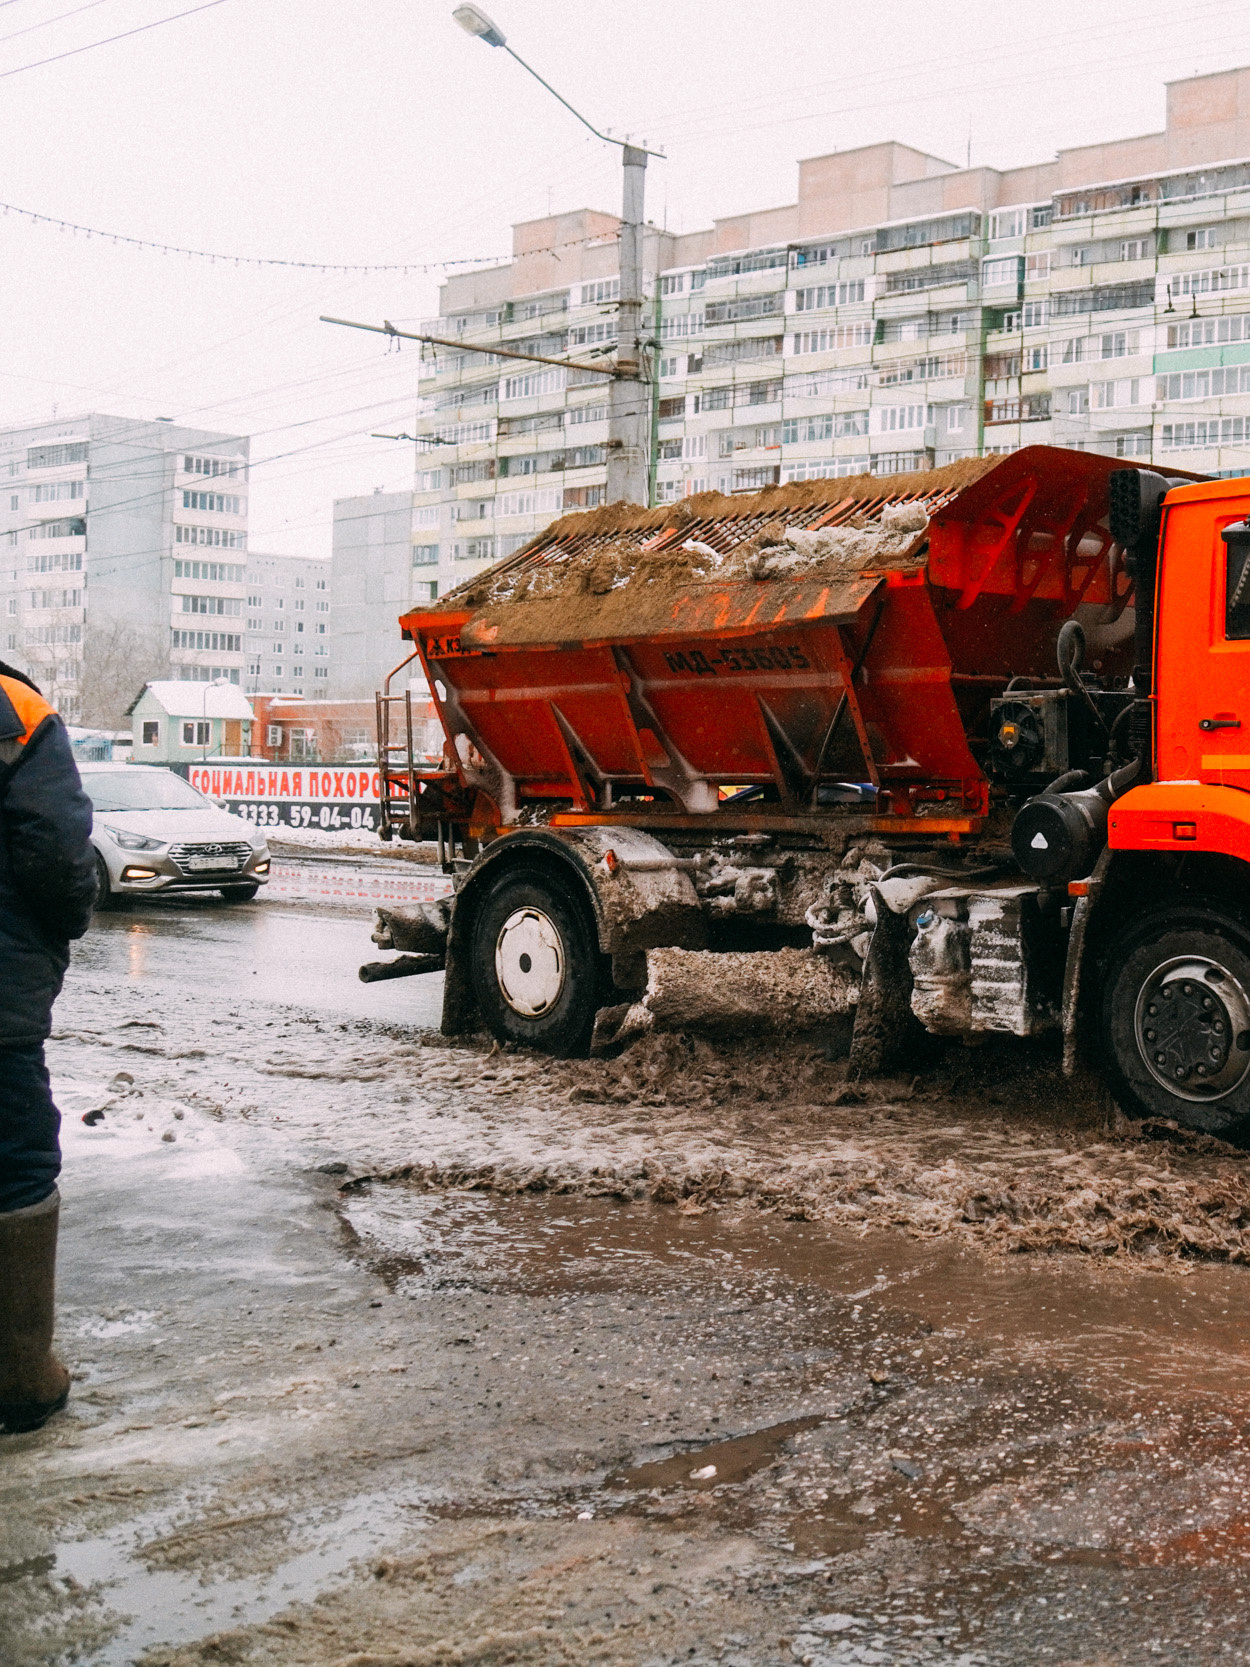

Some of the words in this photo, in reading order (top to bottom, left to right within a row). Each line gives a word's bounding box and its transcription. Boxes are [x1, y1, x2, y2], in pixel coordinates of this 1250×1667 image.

[663, 645, 811, 676] МД-53605
[192, 769, 302, 798] СОЦИАЛЬНАЯ
[290, 805, 374, 829] 59-04-04
